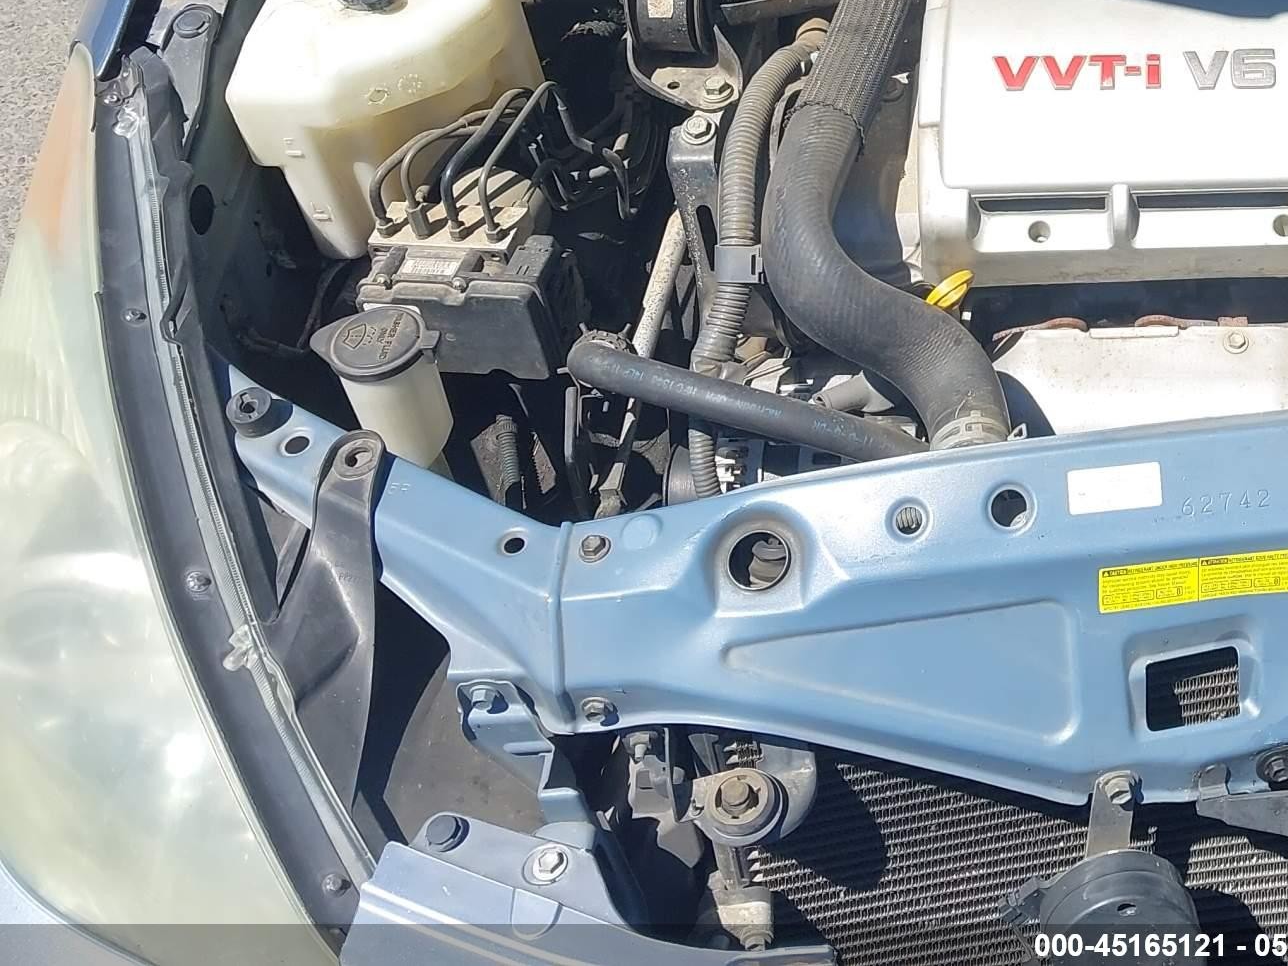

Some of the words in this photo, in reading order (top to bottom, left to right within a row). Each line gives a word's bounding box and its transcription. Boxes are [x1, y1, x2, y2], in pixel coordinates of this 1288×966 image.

[992, 54, 1162, 91] VVT-i
[1183, 48, 1277, 91] V6
[377, 327, 388, 344] ONLY
[387, 312, 405, 338] WASHER
[378, 340, 393, 360] FLUID
[1181, 489, 1272, 517] 62742
